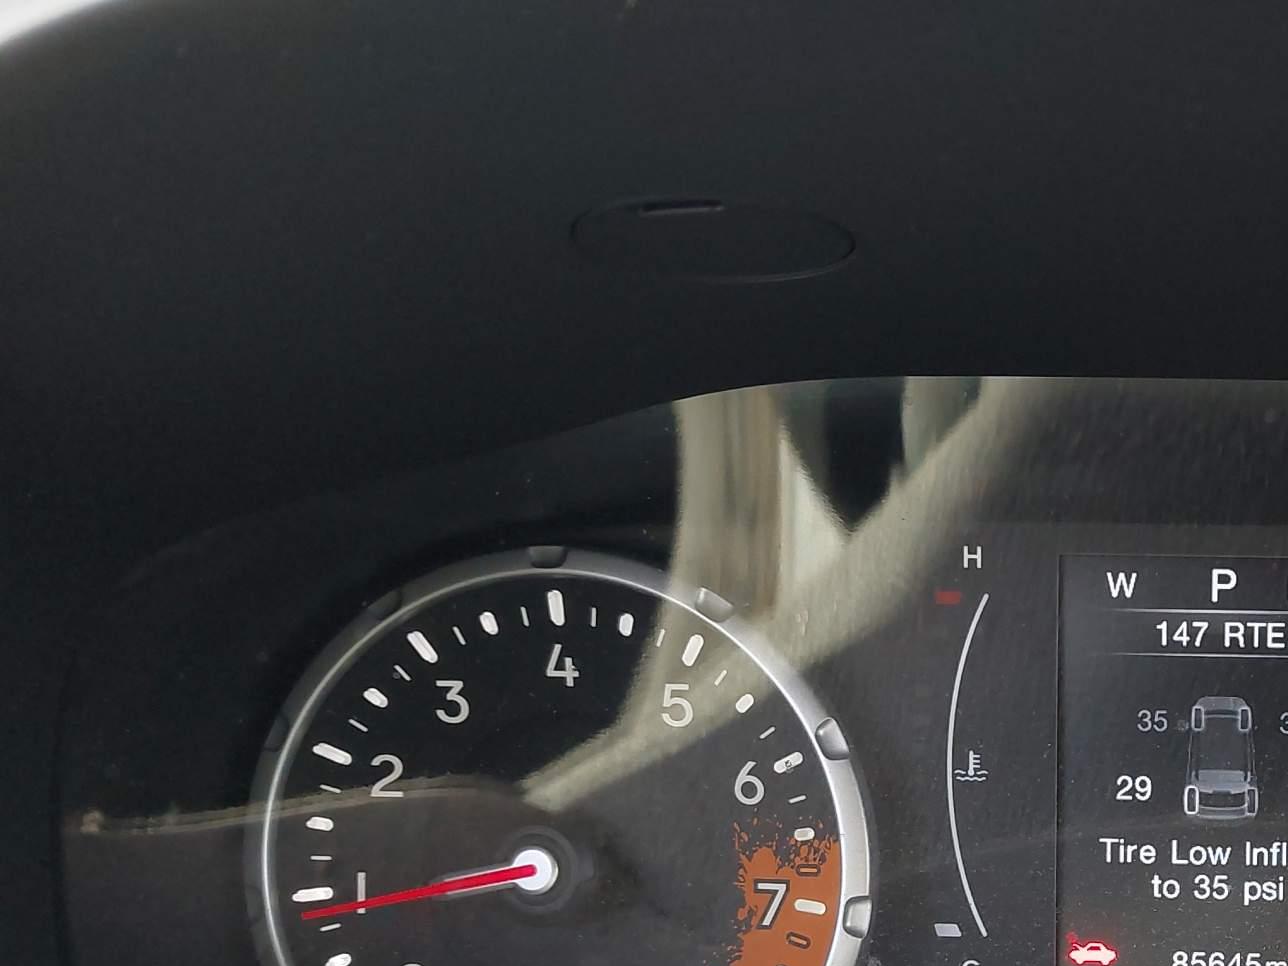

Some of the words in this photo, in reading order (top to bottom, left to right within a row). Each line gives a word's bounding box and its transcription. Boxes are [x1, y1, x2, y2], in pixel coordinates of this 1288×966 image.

[963, 547, 982, 568] H
[1107, 573, 1136, 598] W
[1212, 570, 1237, 601] P
[1156, 623, 1209, 647] 147
[1225, 623, 1285, 648] RTE
[547, 644, 579, 686] 4
[437, 680, 470, 724] 3
[662, 684, 693, 727] 5
[1137, 710, 1168, 732] 35
[372, 755, 404, 798] 2
[734, 761, 764, 805] 6
[1116, 777, 1152, 800] 29
[1099, 839, 1156, 864] Tire
[1171, 841, 1231, 865] Low
[357, 872, 366, 914] 1
[754, 880, 787, 928] 7
[1152, 876, 1179, 898] to
[1194, 876, 1228, 899] 35
[1244, 876, 1283, 906] psi
